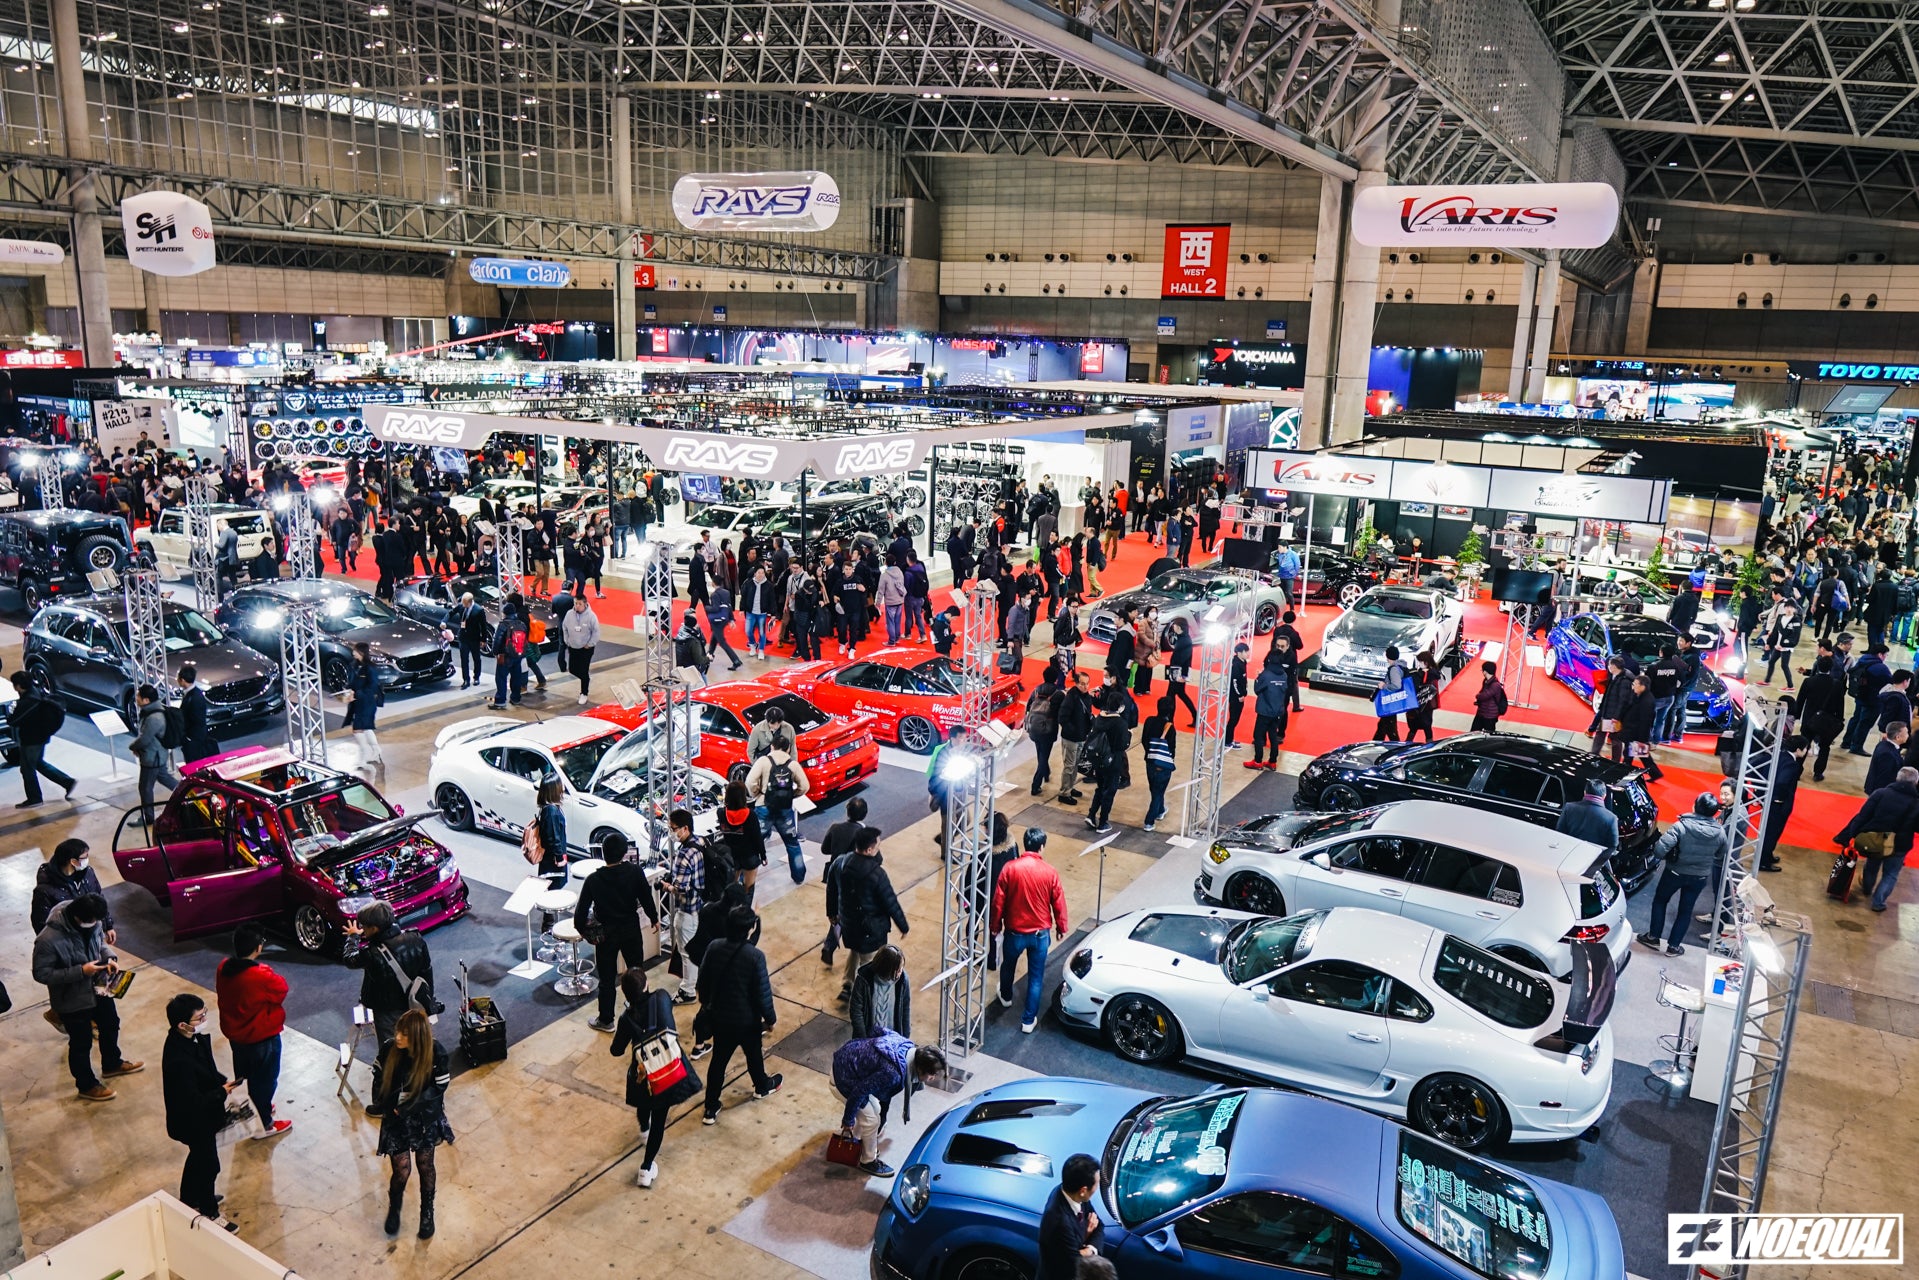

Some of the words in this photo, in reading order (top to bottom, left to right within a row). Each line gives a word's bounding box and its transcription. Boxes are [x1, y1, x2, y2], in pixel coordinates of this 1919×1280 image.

[692, 186, 811, 216] RAYS
[1398, 196, 1558, 233] VARIS
[1179, 231, 1214, 267] 西
[641, 272, 650, 285] 3
[1183, 268, 1206, 276] WEST
[1170, 282, 1202, 294] HALL
[1204, 278, 1217, 294] 2
[951, 340, 996, 350] NISSAN
[1233, 350, 1296, 364] YOKOHAMA
[1819, 364, 1881, 379] TOYO
[1883, 366, 1919, 380] TIR
[440, 390, 474, 401] KUHL
[476, 389, 511, 400] JAPAN
[102, 407, 129, 422] #214
[381, 411, 465, 443] RAYS
[664, 437, 778, 474] RAYS
[835, 439, 915, 474] RAYS
